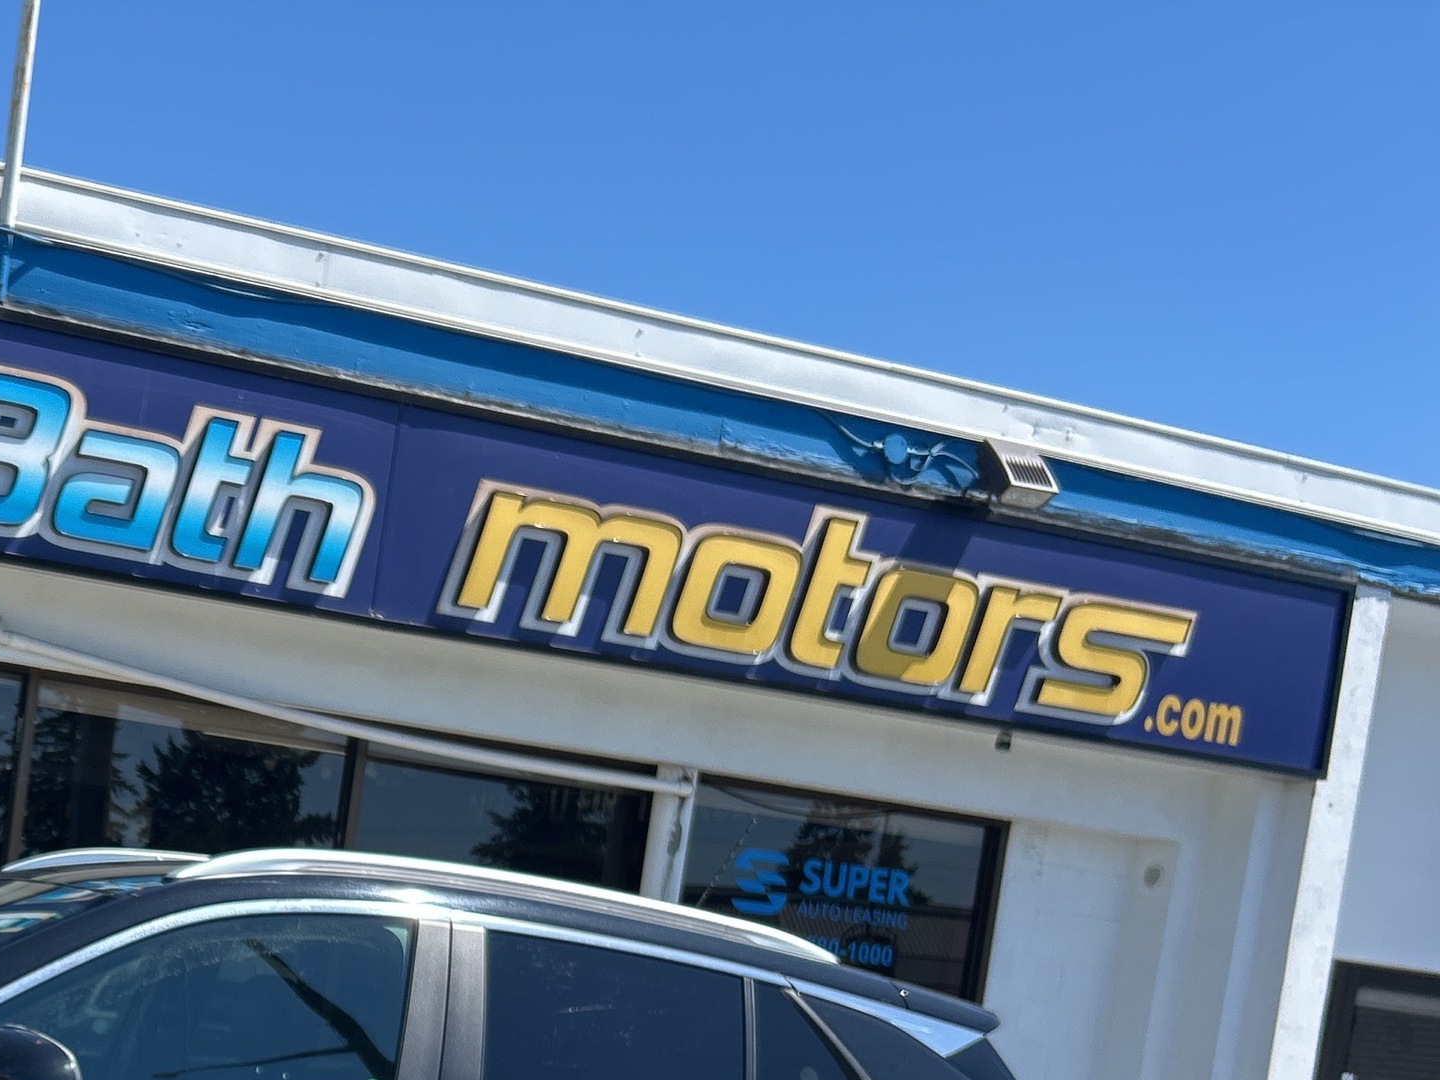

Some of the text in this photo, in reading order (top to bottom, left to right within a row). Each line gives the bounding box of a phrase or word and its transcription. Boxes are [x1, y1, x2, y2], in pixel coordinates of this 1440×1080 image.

[435, 479, 1200, 725] motors
[1144, 694, 1242, 747] .com
[799, 858, 910, 907] SUPER
[797, 900, 909, 930] AUTO LEASING
